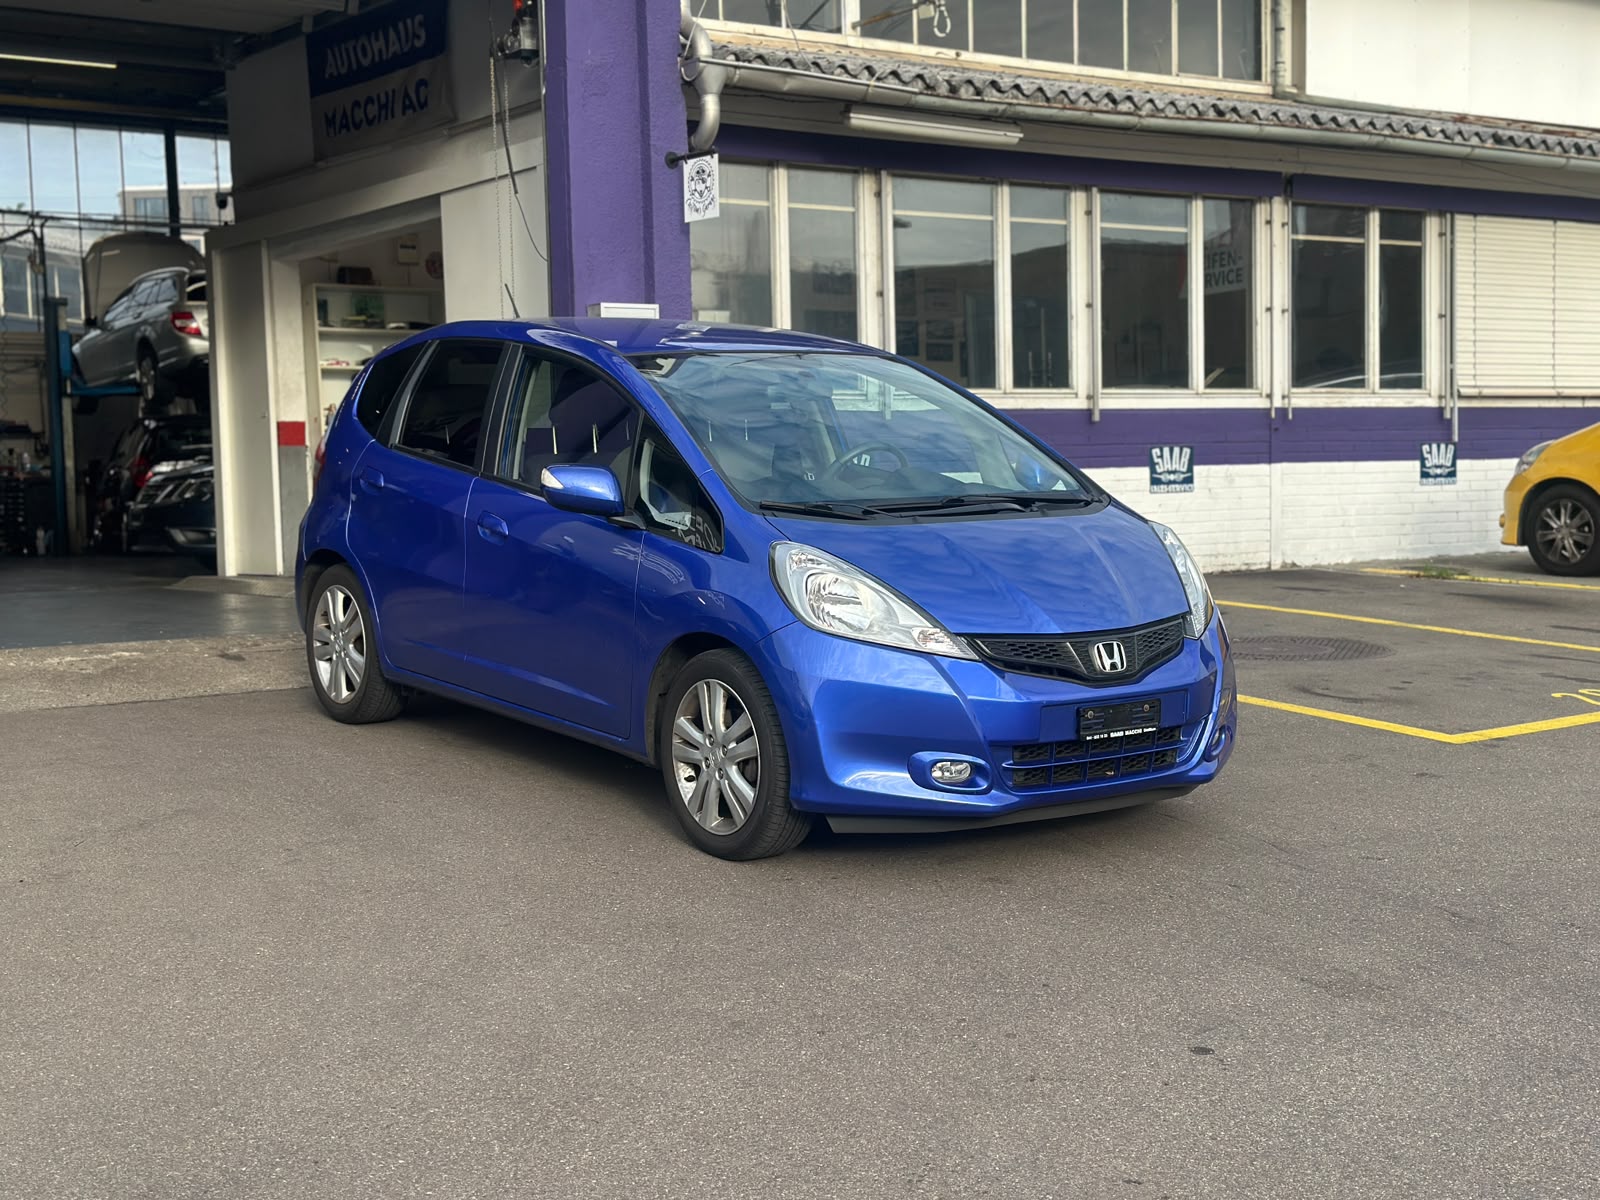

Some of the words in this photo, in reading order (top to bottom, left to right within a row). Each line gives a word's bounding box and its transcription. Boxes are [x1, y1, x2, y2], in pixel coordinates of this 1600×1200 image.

[324, 14, 426, 79] AUTOHAUS
[324, 87, 397, 137] MACCHI
[1151, 446, 1191, 473] SAAB
[1422, 442, 1455, 467] SAAB
